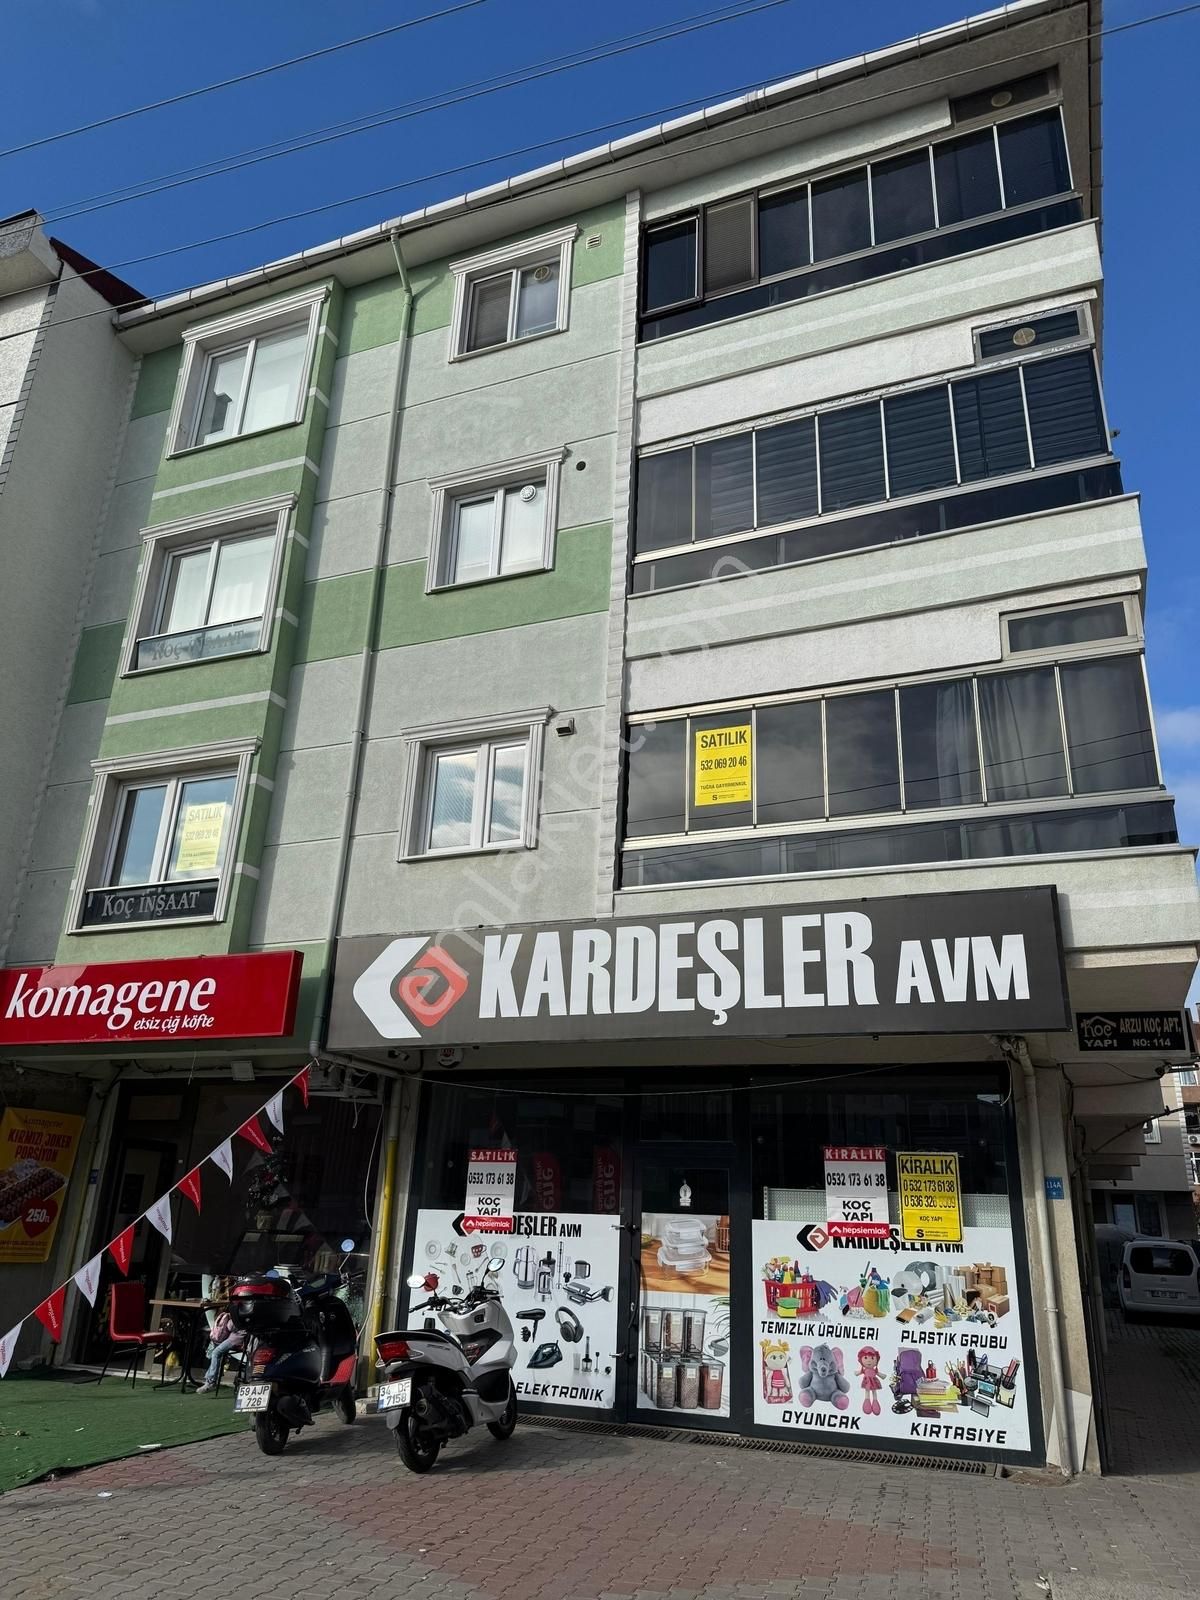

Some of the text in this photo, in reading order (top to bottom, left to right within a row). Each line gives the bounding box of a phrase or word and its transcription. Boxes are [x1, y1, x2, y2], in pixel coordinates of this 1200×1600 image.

[700, 729, 748, 749] SATILIK
[700, 755, 747, 771] 532 069 20 46
[189, 806, 223, 822] SATILIK
[139, 891, 200, 916] İNŞAAT
[479, 911, 1031, 1026] KARDEŞLER AVM
[5, 973, 217, 1030] komagene
[134, 1013, 215, 1034] etsiz çiğ köfte
[1120, 1017, 1181, 1036] ARZU KOÇ APT.
[1084, 1039, 1118, 1047] YAPI
[1132, 1038, 1171, 1047] NO: 114
[45, 1133, 72, 1148] JOKER
[471, 1151, 515, 1160] SATILIK
[900, 1157, 954, 1175] KİRALIK
[468, 1172, 514, 1185] 0532 173 61 38
[826, 1172, 885, 1187] 0532 173 61 38
[903, 1179, 955, 1192] 0 532 173 6138
[478, 1197, 501, 1207] KOÇ
[842, 1200, 871, 1211] KOÇ
[904, 1194, 909, 1207] 0
[910, 1195, 923, 1207] 536
[477, 1207, 501, 1216] YAPI
[842, 1211, 873, 1221] YAPI
[475, 1220, 510, 1228] hepsiemlak
[843, 1226, 886, 1235] hepsiemlak
[559, 1224, 582, 1238] AVM
[960, 1334, 1008, 1349] GRUBU
[240, 1386, 270, 1396] 59 AJP
[380, 1386, 390, 1396] 34
[246, 1397, 262, 1407] 726
[782, 1410, 861, 1430] OYUNCAK
